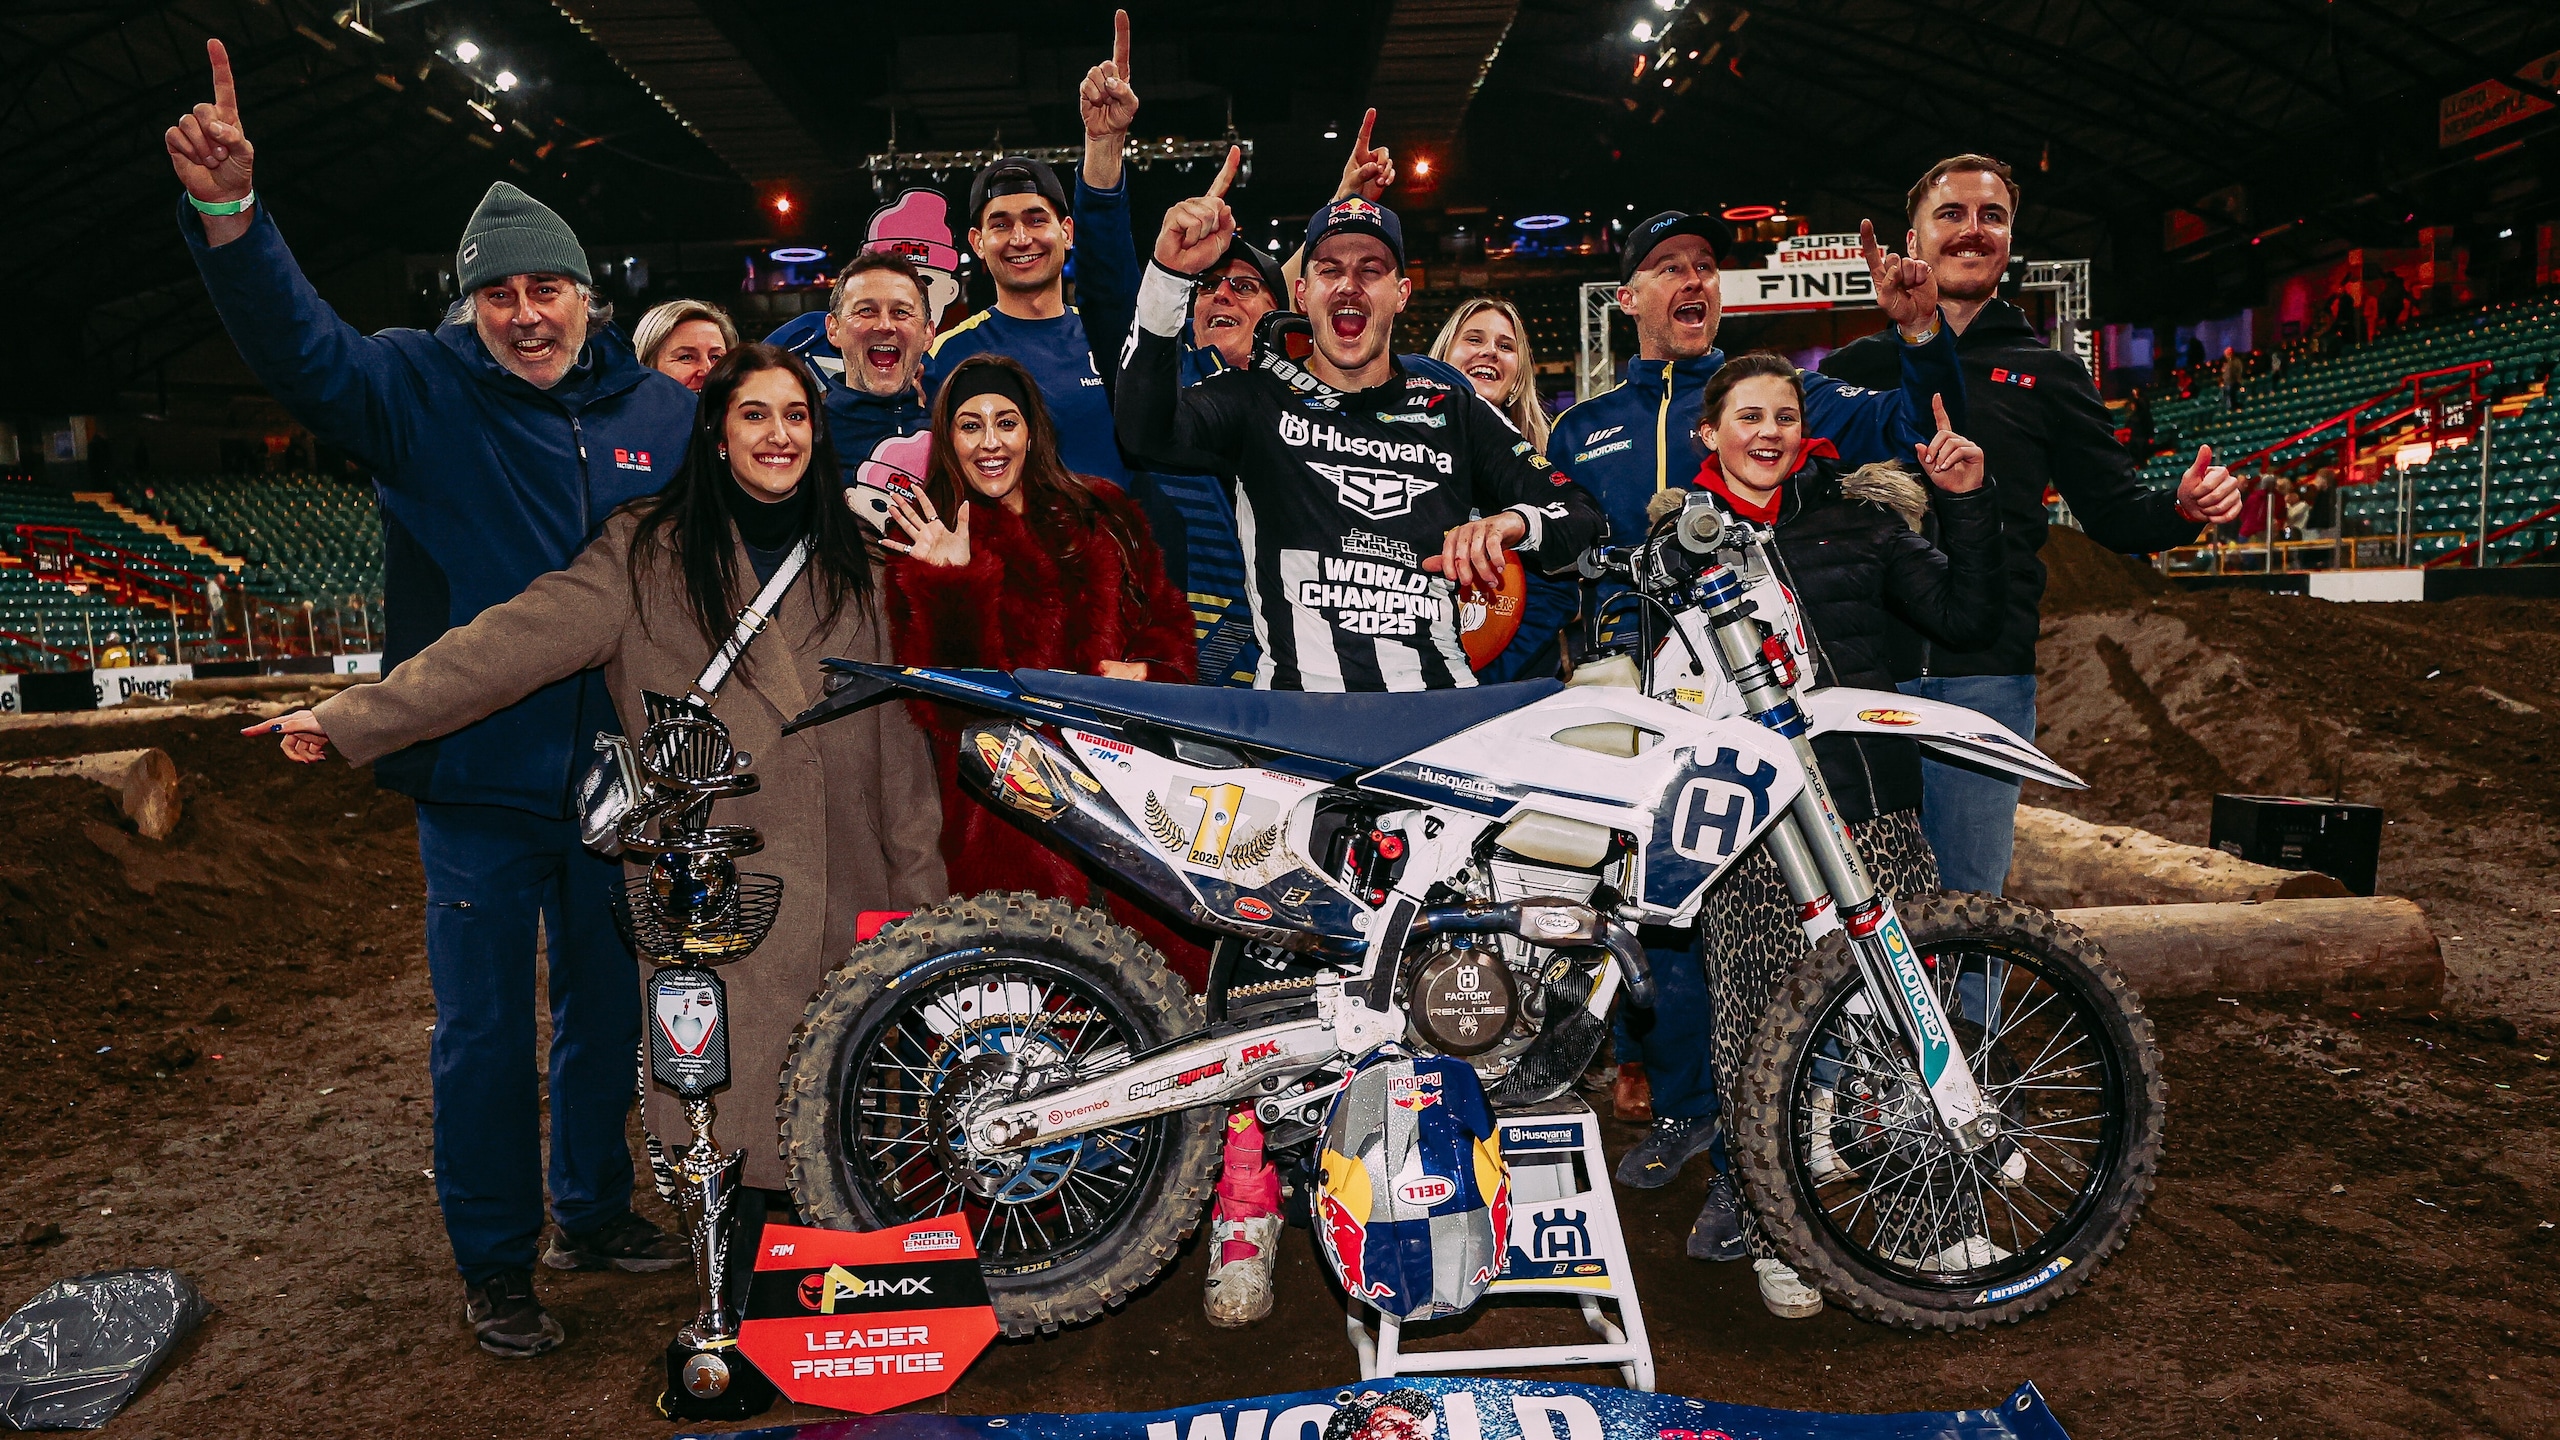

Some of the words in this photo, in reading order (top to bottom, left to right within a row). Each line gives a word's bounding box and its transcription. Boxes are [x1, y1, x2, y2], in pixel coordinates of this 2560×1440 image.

[1791, 235, 1863, 249] SUPE
[906, 254, 927, 262] ORE
[1780, 248, 1885, 263] ENDUR
[1757, 271, 1873, 299] FINIS
[1259, 350, 1344, 409] 100%
[1588, 440, 1632, 459] MOTOREX
[886, 482, 917, 500] STOR
[1325, 557, 1428, 594] WORLD
[1302, 583, 1440, 620] CHAMPION
[1339, 610, 1416, 635] 2025
[120, 676, 173, 699] Divers
[1088, 747, 1120, 763] FIM
[1417, 766, 1497, 794] Husqvarna
[1805, 764, 1826, 799] XPLOR
[1454, 790, 1475, 799] FACTORY
[1476, 794, 1494, 803] RACING
[1187, 782, 1245, 869] 1
[1192, 850, 1219, 865] 2025
[1844, 851, 1861, 877] SKF
[1237, 902, 1257, 913] Twin
[1256, 906, 1271, 916] Air
[1855, 911, 1877, 926] WP
[1445, 991, 1491, 1001] FACTORY
[1895, 952, 1947, 1051] MOTOREX
[1430, 1006, 1506, 1016] REKLUSE
[1242, 1040, 1277, 1063] RK
[1129, 1059, 1228, 1101] Supersprox
[1388, 1077, 1415, 1092] Bull
[1415, 1072, 1442, 1090] Red
[1064, 1100, 1110, 1119] brembo
[1522, 1129, 1573, 1141] Husqvarna
[1405, 1183, 1446, 1199] BELL
[905, 1239, 959, 1247] ENDURO
[910, 1231, 954, 1240] SUPER
[769, 1243, 796, 1257] FIM
[1013, 1260, 1052, 1274] EXCEL
[1991, 1268, 2050, 1299] MICHELIN
[804, 1325, 929, 1351] LEADER
[791, 1352, 944, 1379] PRESTIGE
